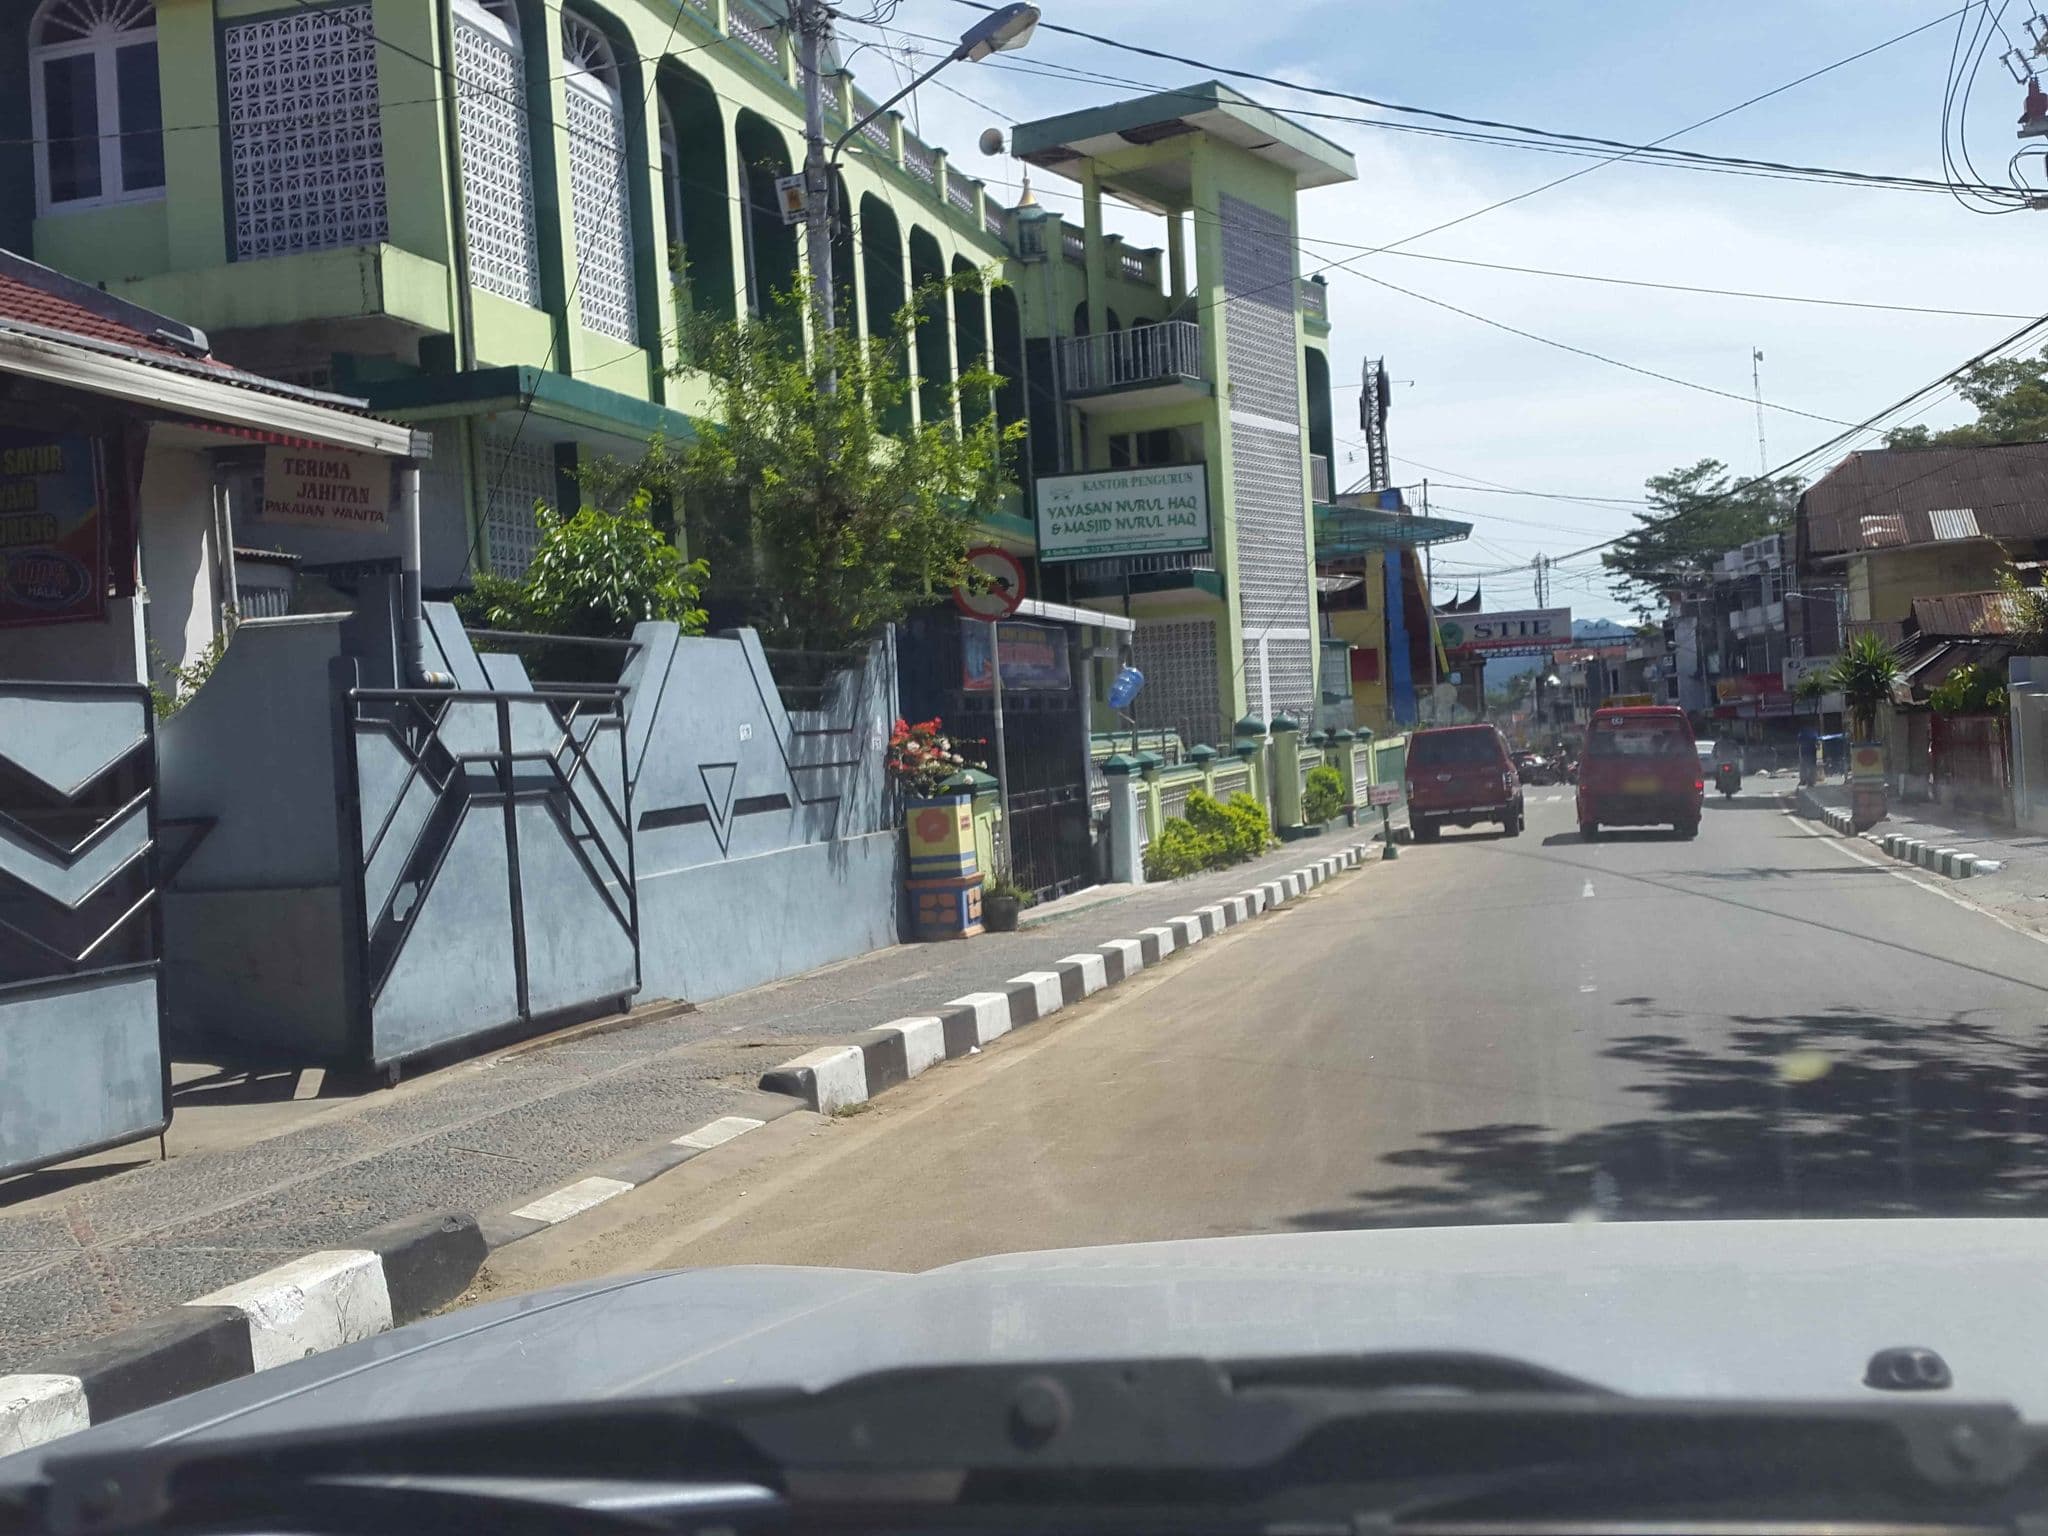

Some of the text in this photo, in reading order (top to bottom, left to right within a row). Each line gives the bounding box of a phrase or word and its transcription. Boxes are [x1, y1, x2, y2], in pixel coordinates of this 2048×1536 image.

[282, 458, 351, 480] TERIMA
[296, 481, 371, 504] JAHITAN
[1082, 472, 1193, 492] KANTOR PENGURUS
[264, 500, 385, 522] PAKAIAN WANITA
[1046, 495, 1198, 519] YAYASAN NURUL HAQ
[1051, 512, 1196, 535] & MASJID NURUL HAQ
[1473, 620, 1552, 638] STIE
